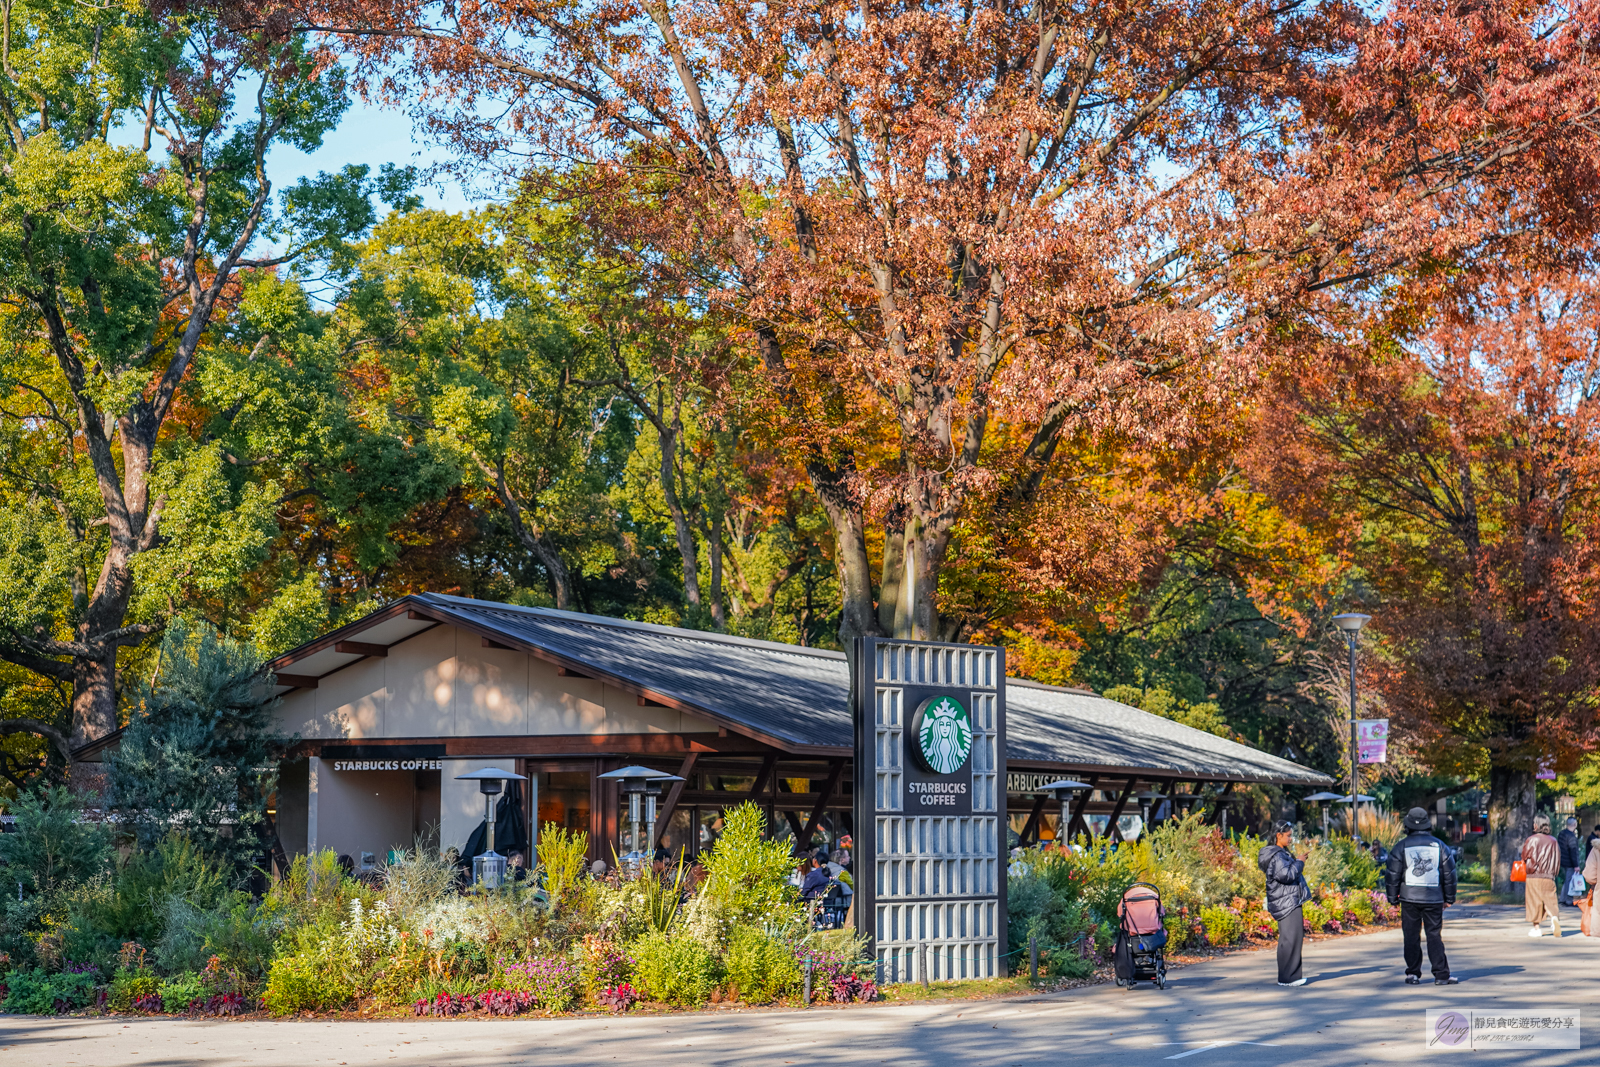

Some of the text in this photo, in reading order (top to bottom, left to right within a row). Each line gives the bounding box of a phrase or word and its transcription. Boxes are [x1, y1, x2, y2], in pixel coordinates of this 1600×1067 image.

[334, 760, 442, 771] STARBUCKS COFFEE
[908, 782, 967, 794] STARBUCKS
[920, 795, 956, 805] COFFEE
